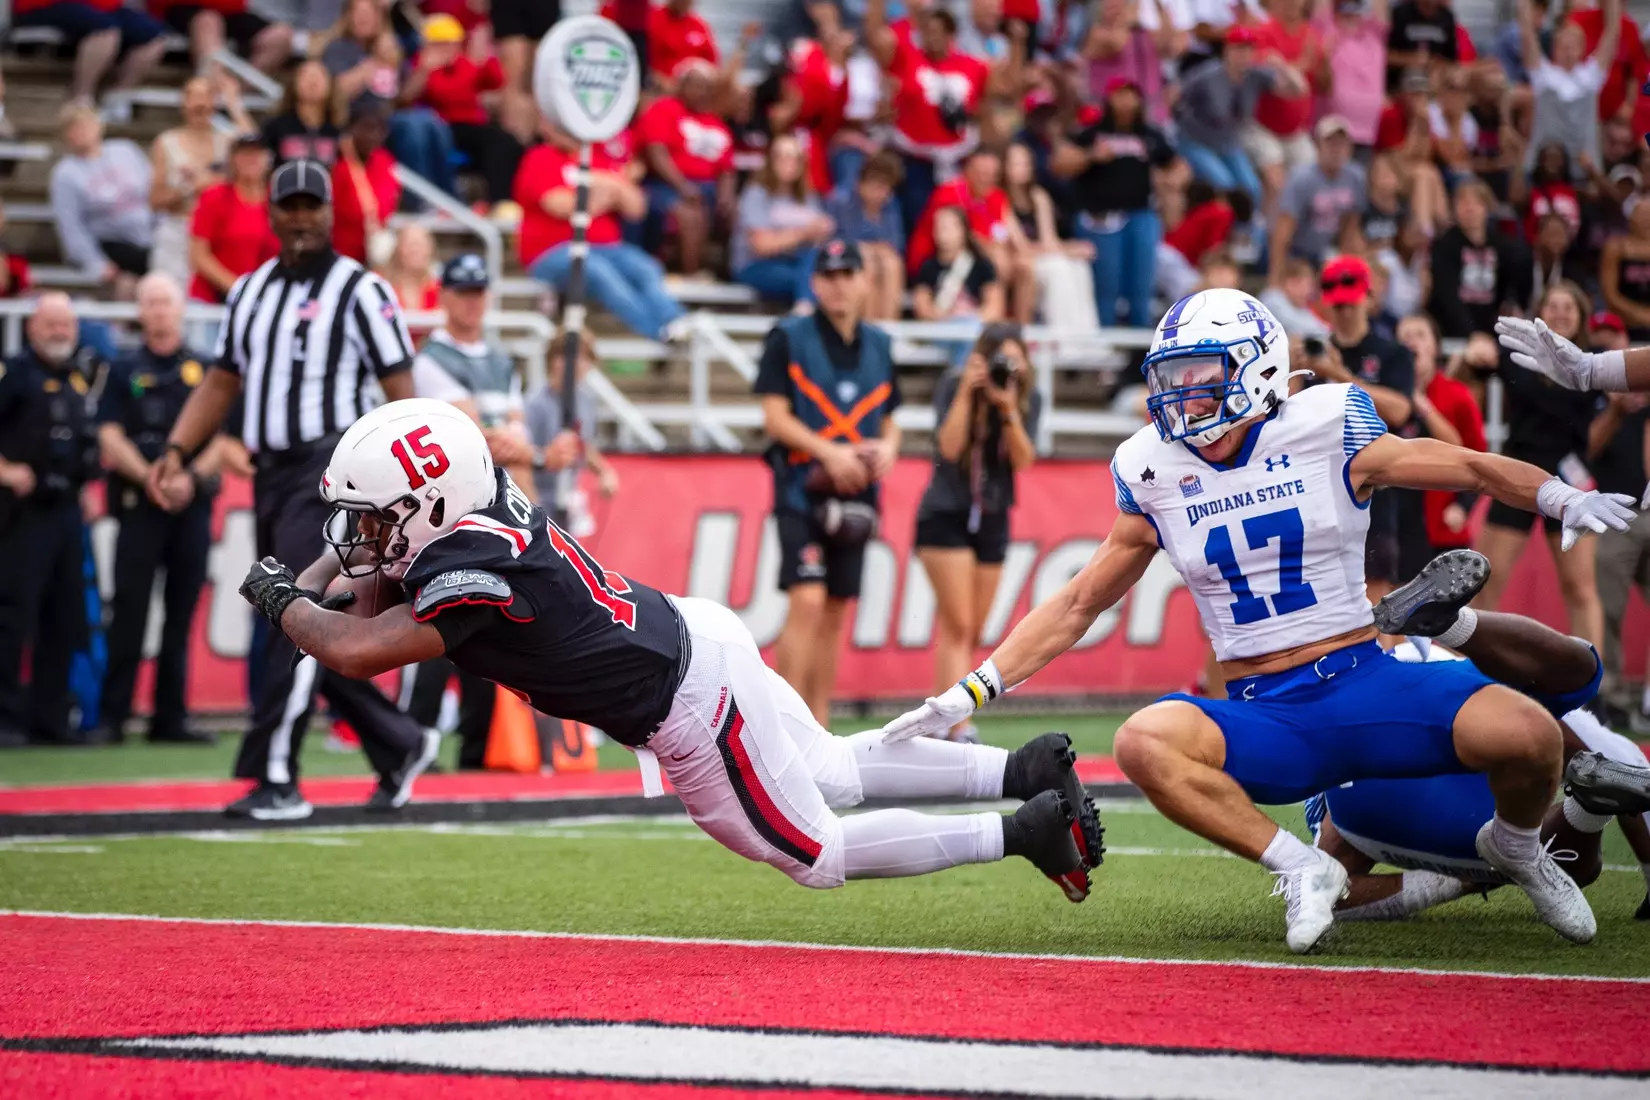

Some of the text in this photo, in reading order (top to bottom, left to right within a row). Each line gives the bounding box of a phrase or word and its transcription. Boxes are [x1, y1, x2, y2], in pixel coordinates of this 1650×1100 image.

[390, 425, 450, 491] 15
[1186, 479, 1305, 527] INDIANA STATE
[1204, 507, 1318, 625] 17
[710, 686, 727, 728] CARDINALS
